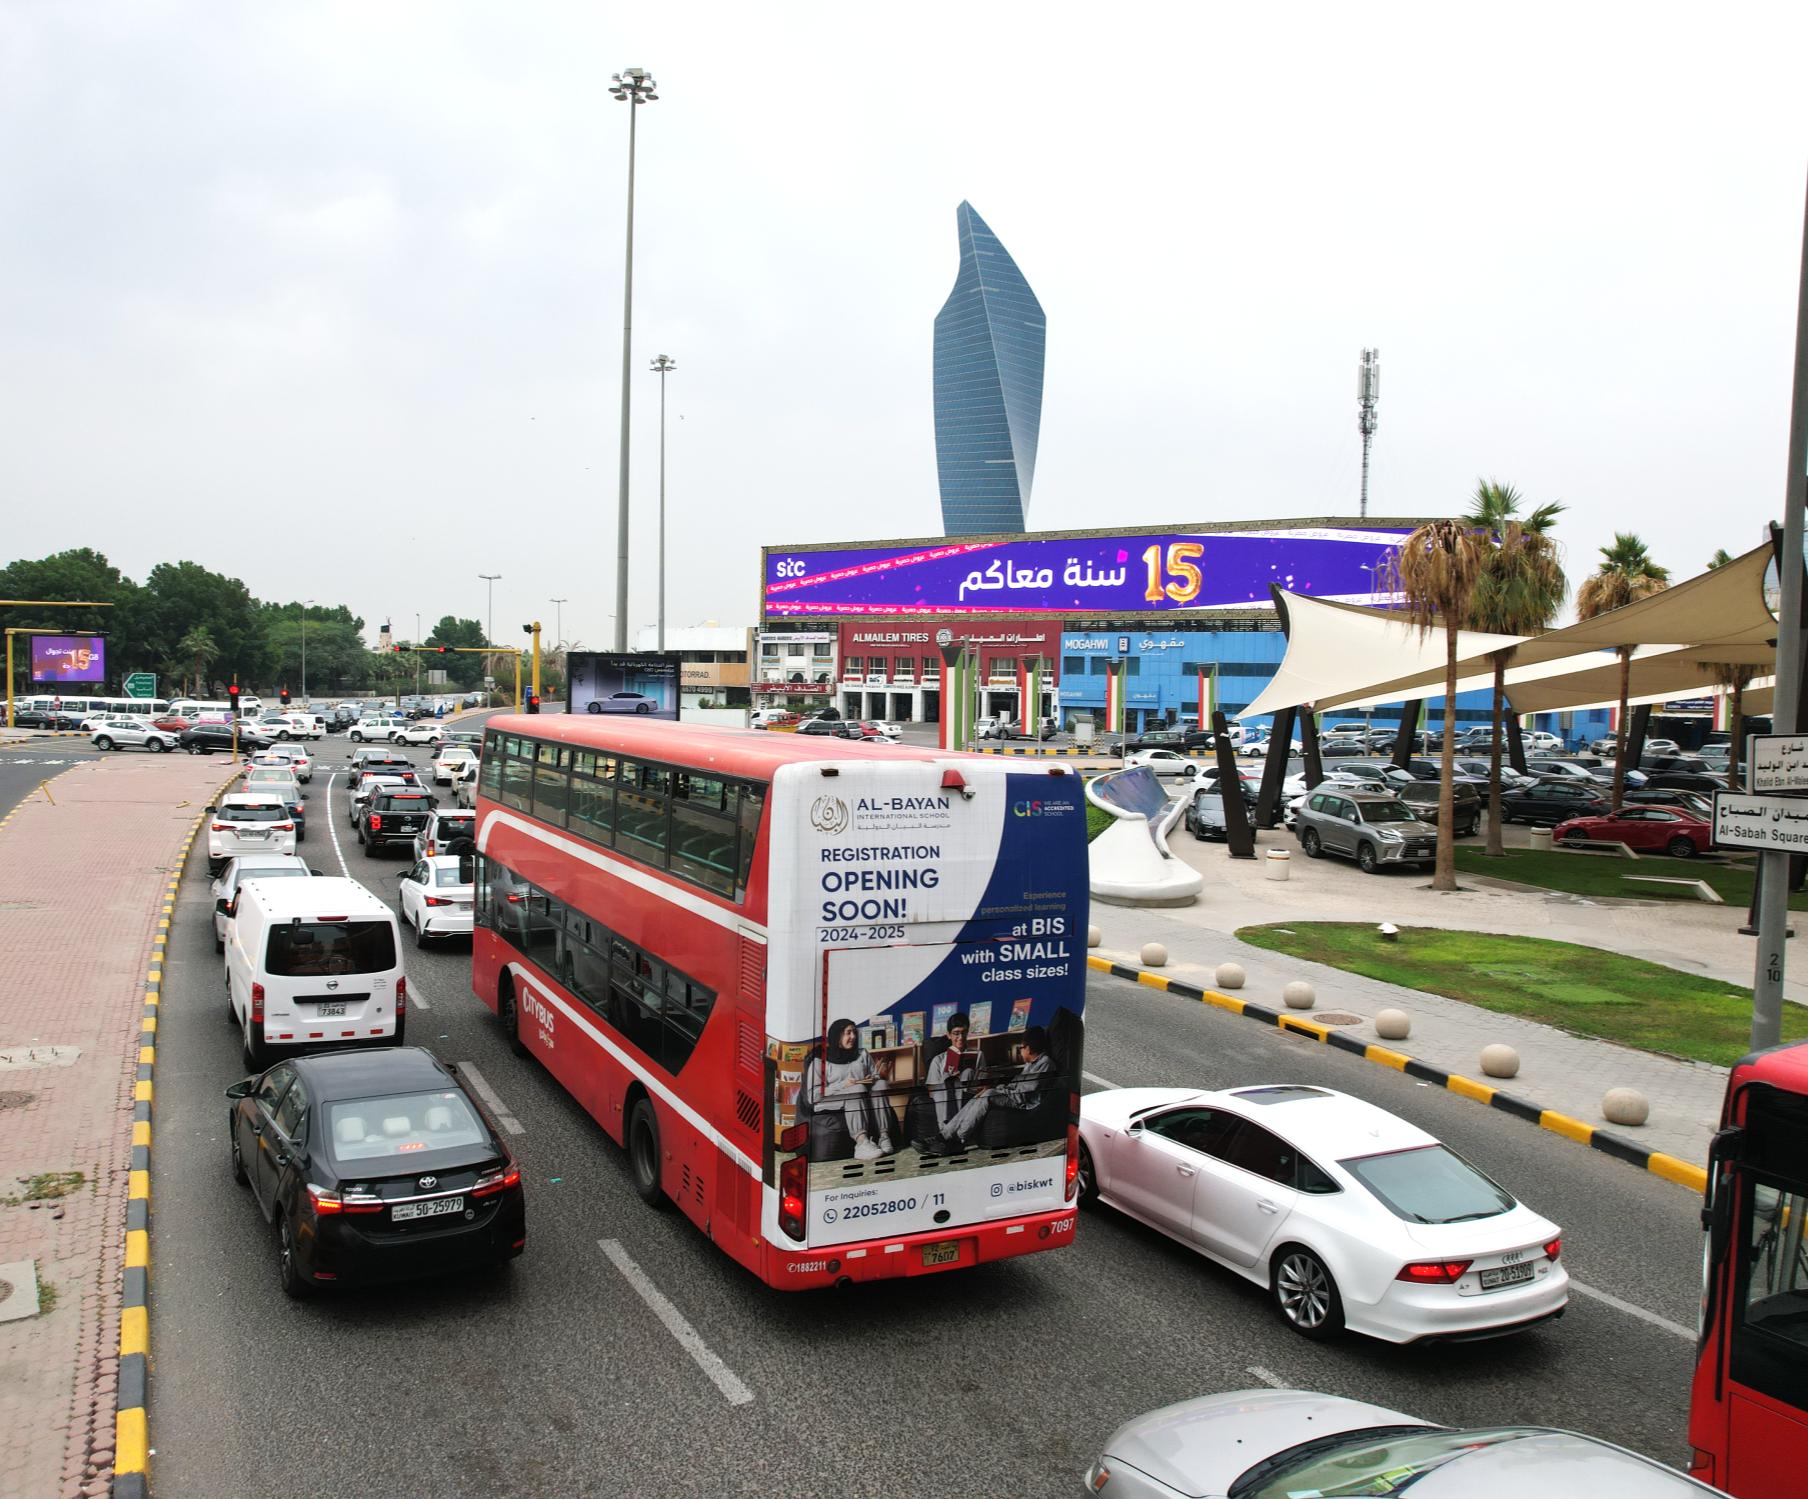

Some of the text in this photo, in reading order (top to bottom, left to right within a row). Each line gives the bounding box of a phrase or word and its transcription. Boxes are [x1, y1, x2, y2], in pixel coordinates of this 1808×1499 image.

[776, 558, 806, 577] stc
[958, 543, 1204, 603] 15 سنة معاكم
[852, 633, 929, 642] ALMAILEM TIRES
[1065, 639, 1108, 650] MOGAHWI
[1782, 741, 1804, 755] شارع
[1757, 761, 1783, 773] الوليد
[1787, 761, 1799, 772] ابن
[857, 797, 950, 810] AL-BAYAN
[1720, 804, 1767, 817] الصباح
[1719, 824, 1808, 843] Al-Sabah Square
[821, 845, 940, 862] REGISTRATION
[821, 868, 939, 893] OPENING
[1023, 892, 1066, 901] Experience
[822, 898, 907, 922] SOON!
[820, 925, 905, 942] 2024-2025
[1012, 918, 1065, 937] at BIS
[961, 942, 1070, 964] with SMALL
[1769, 953, 1779, 965] 2
[981, 963, 1069, 982] class sizes!
[1767, 969, 1780, 982] 10
[1007, 1178, 1053, 1194] @biskwt
[841, 1189, 878, 1200] Inquiries:
[416, 1199, 462, 1216] 50-25979
[843, 1197, 916, 1219] 22052800
[933, 1193, 945, 1206] 11
[1051, 1218, 1074, 1234] 7097
